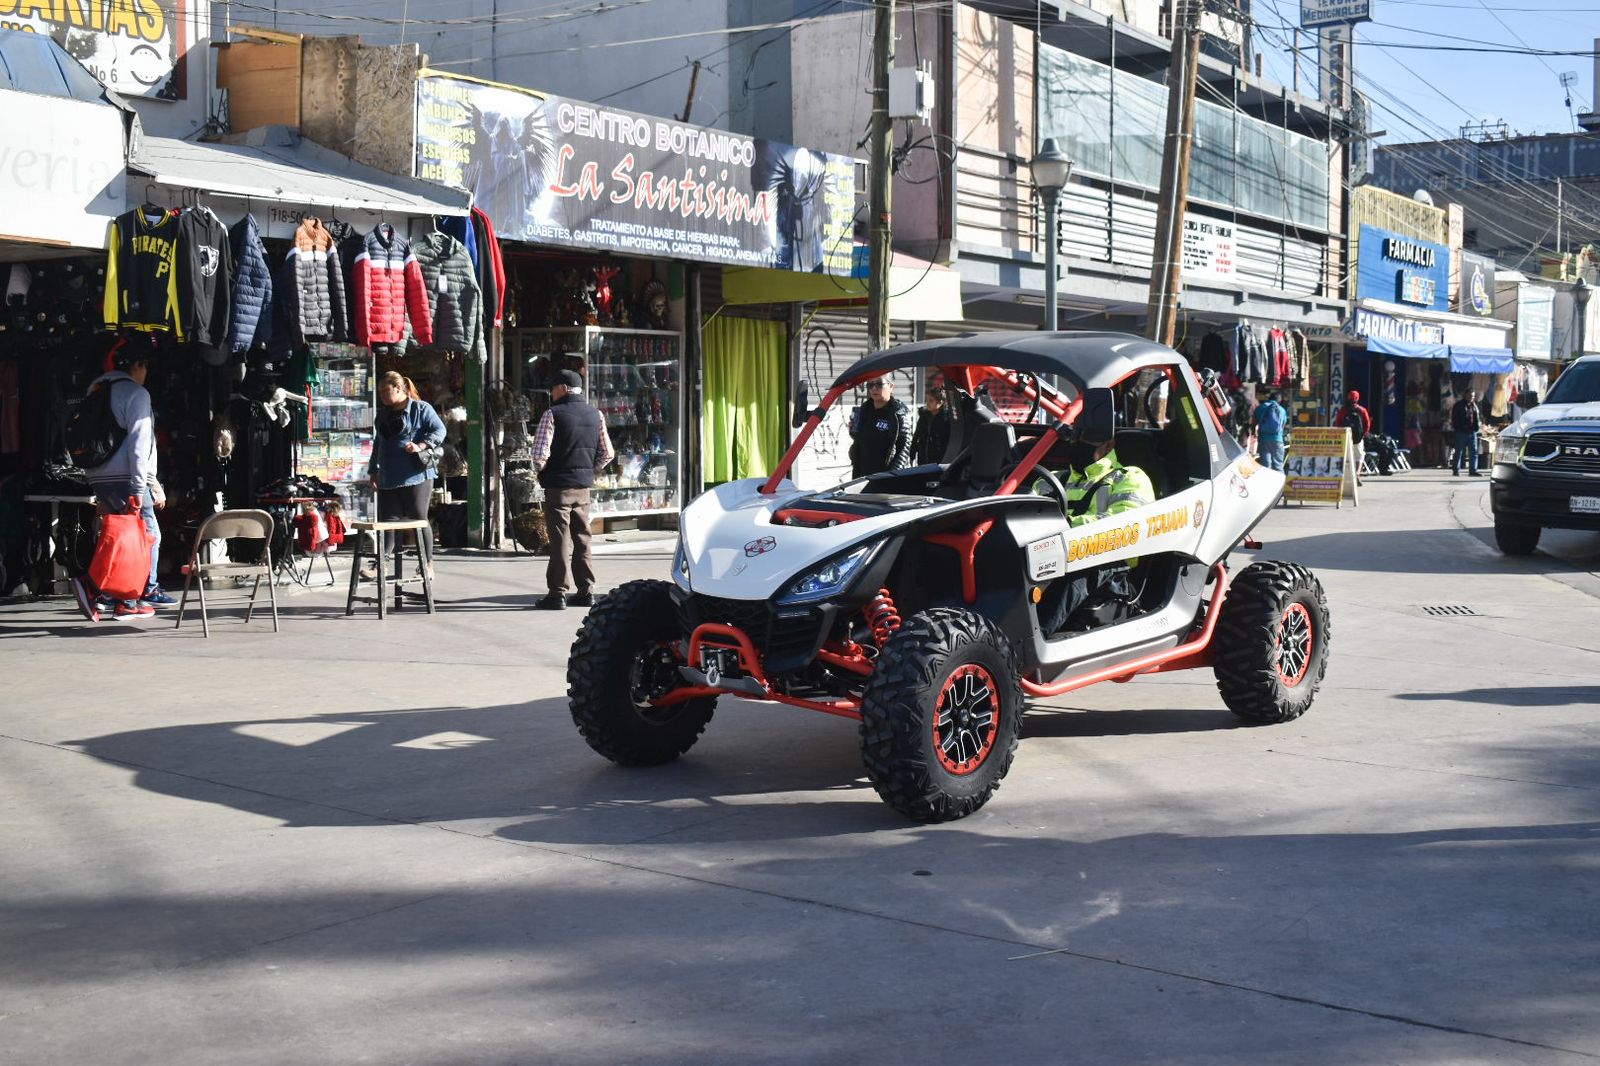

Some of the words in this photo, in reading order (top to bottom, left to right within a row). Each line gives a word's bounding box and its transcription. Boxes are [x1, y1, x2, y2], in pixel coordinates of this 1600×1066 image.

[1302, 3, 1368, 22] MEDICINALES
[110, 68, 118, 83] 6
[557, 103, 651, 148] CENTRO
[655, 122, 756, 168] BOTANICO
[550, 143, 605, 203] La
[610, 152, 773, 226] Santisima
[527, 224, 572, 240] DIABETES,
[573, 229, 619, 247] GASTRITIS,
[735, 250, 760, 261] ANEMIA
[760, 252, 766, 262] Y
[590, 218, 646, 237] TRATAMIENTO
[646, 226, 653, 237] A
[653, 227, 674, 240] BASE
[675, 229, 686, 241] DE
[687, 231, 719, 245] HIERBAS
[719, 235, 740, 247] PARA:
[1388, 238, 1435, 268] FARMACIA
[156, 261, 169, 278] P
[1067, 523, 1140, 563] BOMBEROS
[1146, 505, 1189, 539] TIJUANA
